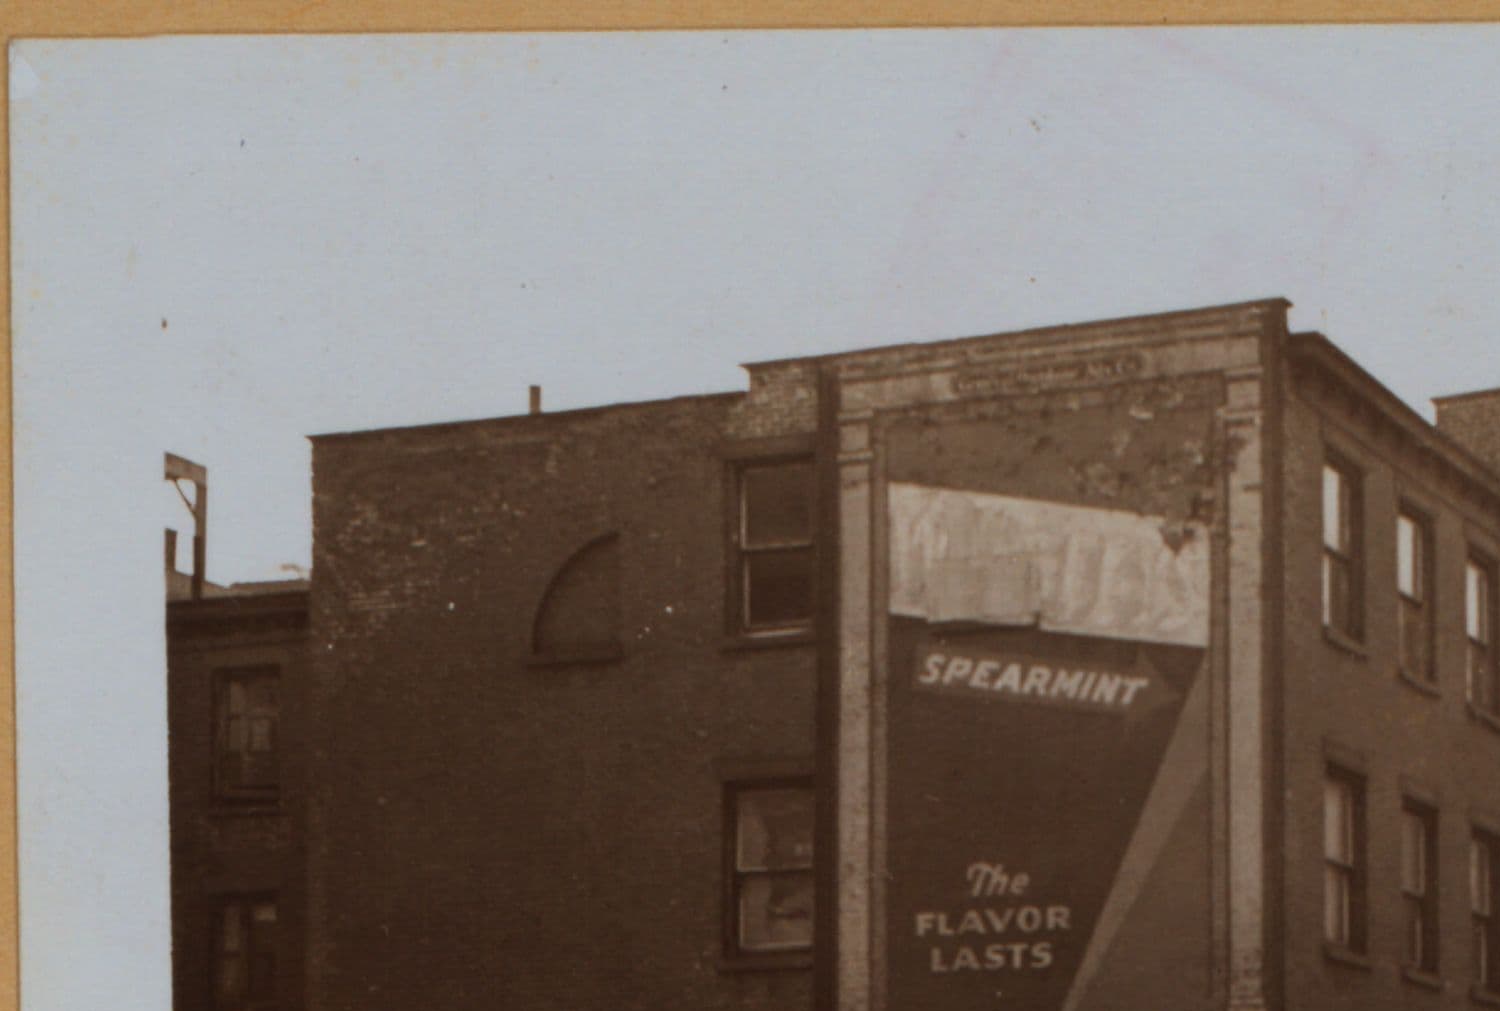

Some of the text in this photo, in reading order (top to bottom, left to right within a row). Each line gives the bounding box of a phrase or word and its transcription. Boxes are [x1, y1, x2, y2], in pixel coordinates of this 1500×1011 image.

[919, 654, 1150, 705] SPEARMINT
[966, 861, 1030, 897] The
[915, 905, 1071, 937] FLAVOR
[930, 942, 1054, 973] LASTS
